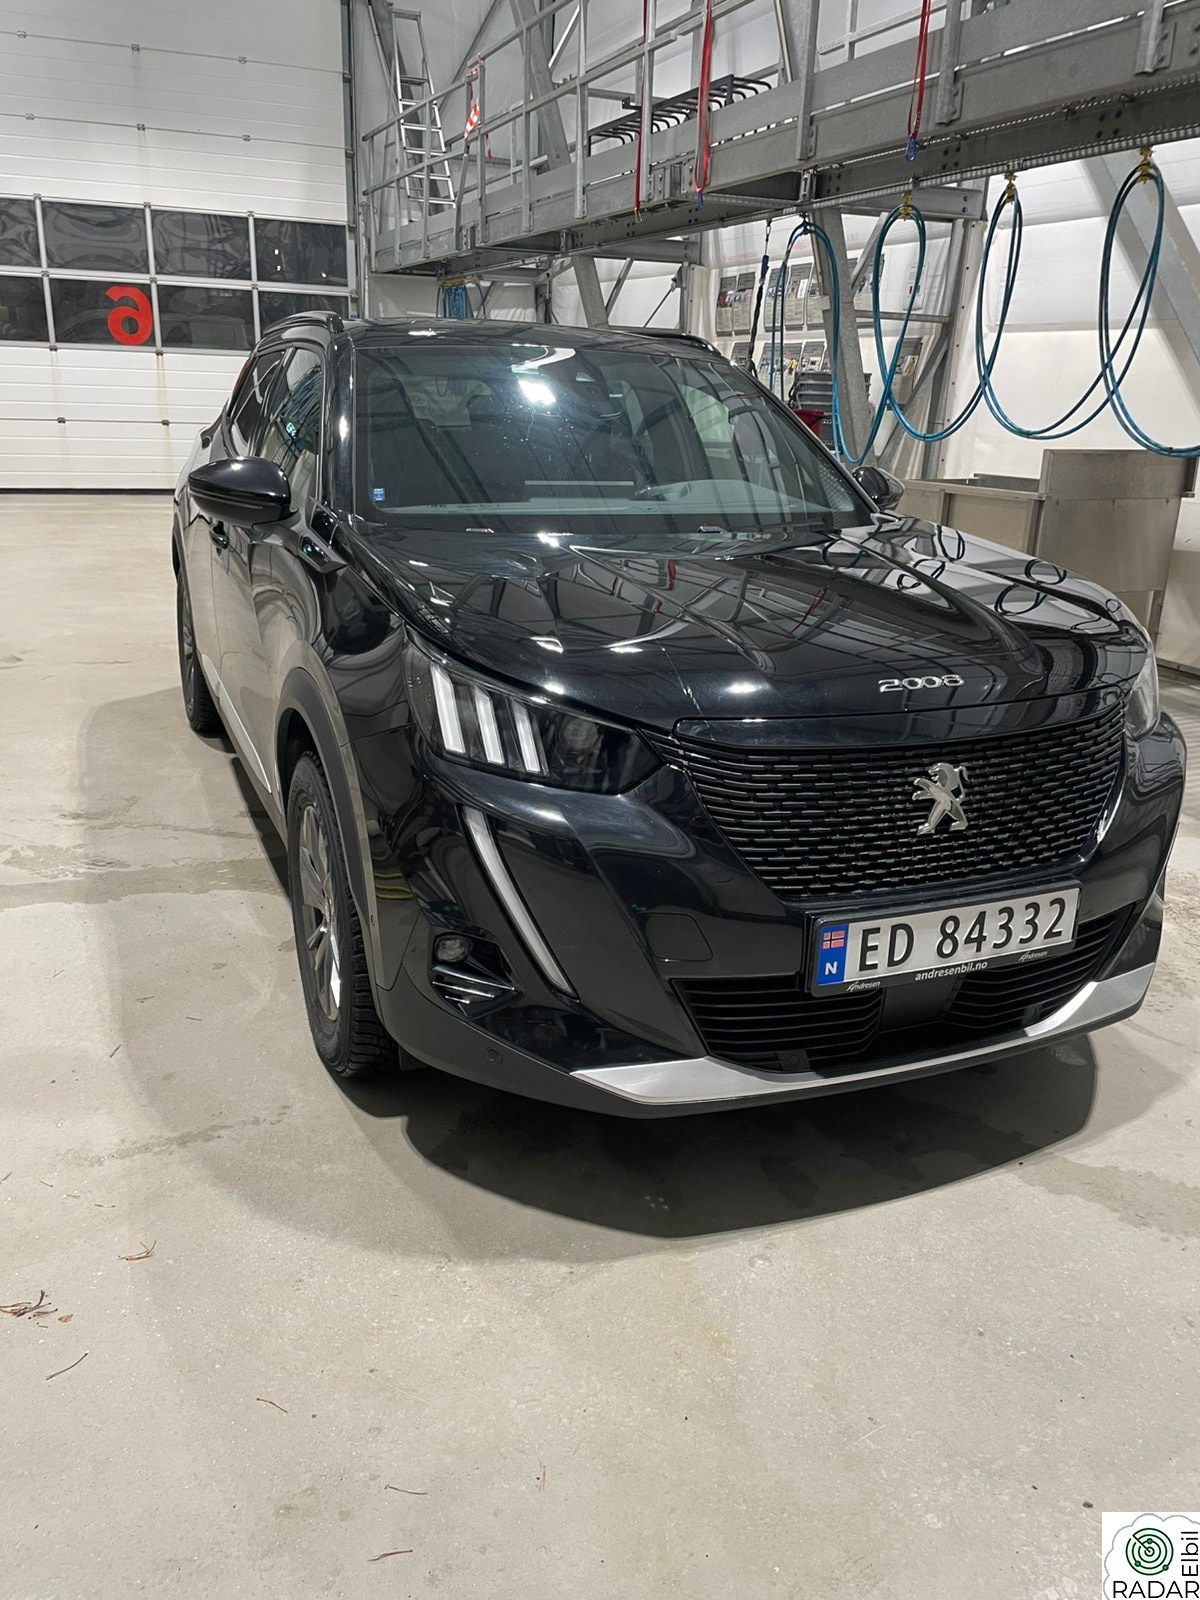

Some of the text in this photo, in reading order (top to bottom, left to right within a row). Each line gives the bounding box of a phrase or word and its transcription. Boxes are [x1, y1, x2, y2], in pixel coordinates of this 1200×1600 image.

[878, 674, 965, 693] 2008
[858, 897, 1066, 972] ED 84332
[824, 962, 838, 976] N
[915, 961, 988, 981] andresenbil.no
